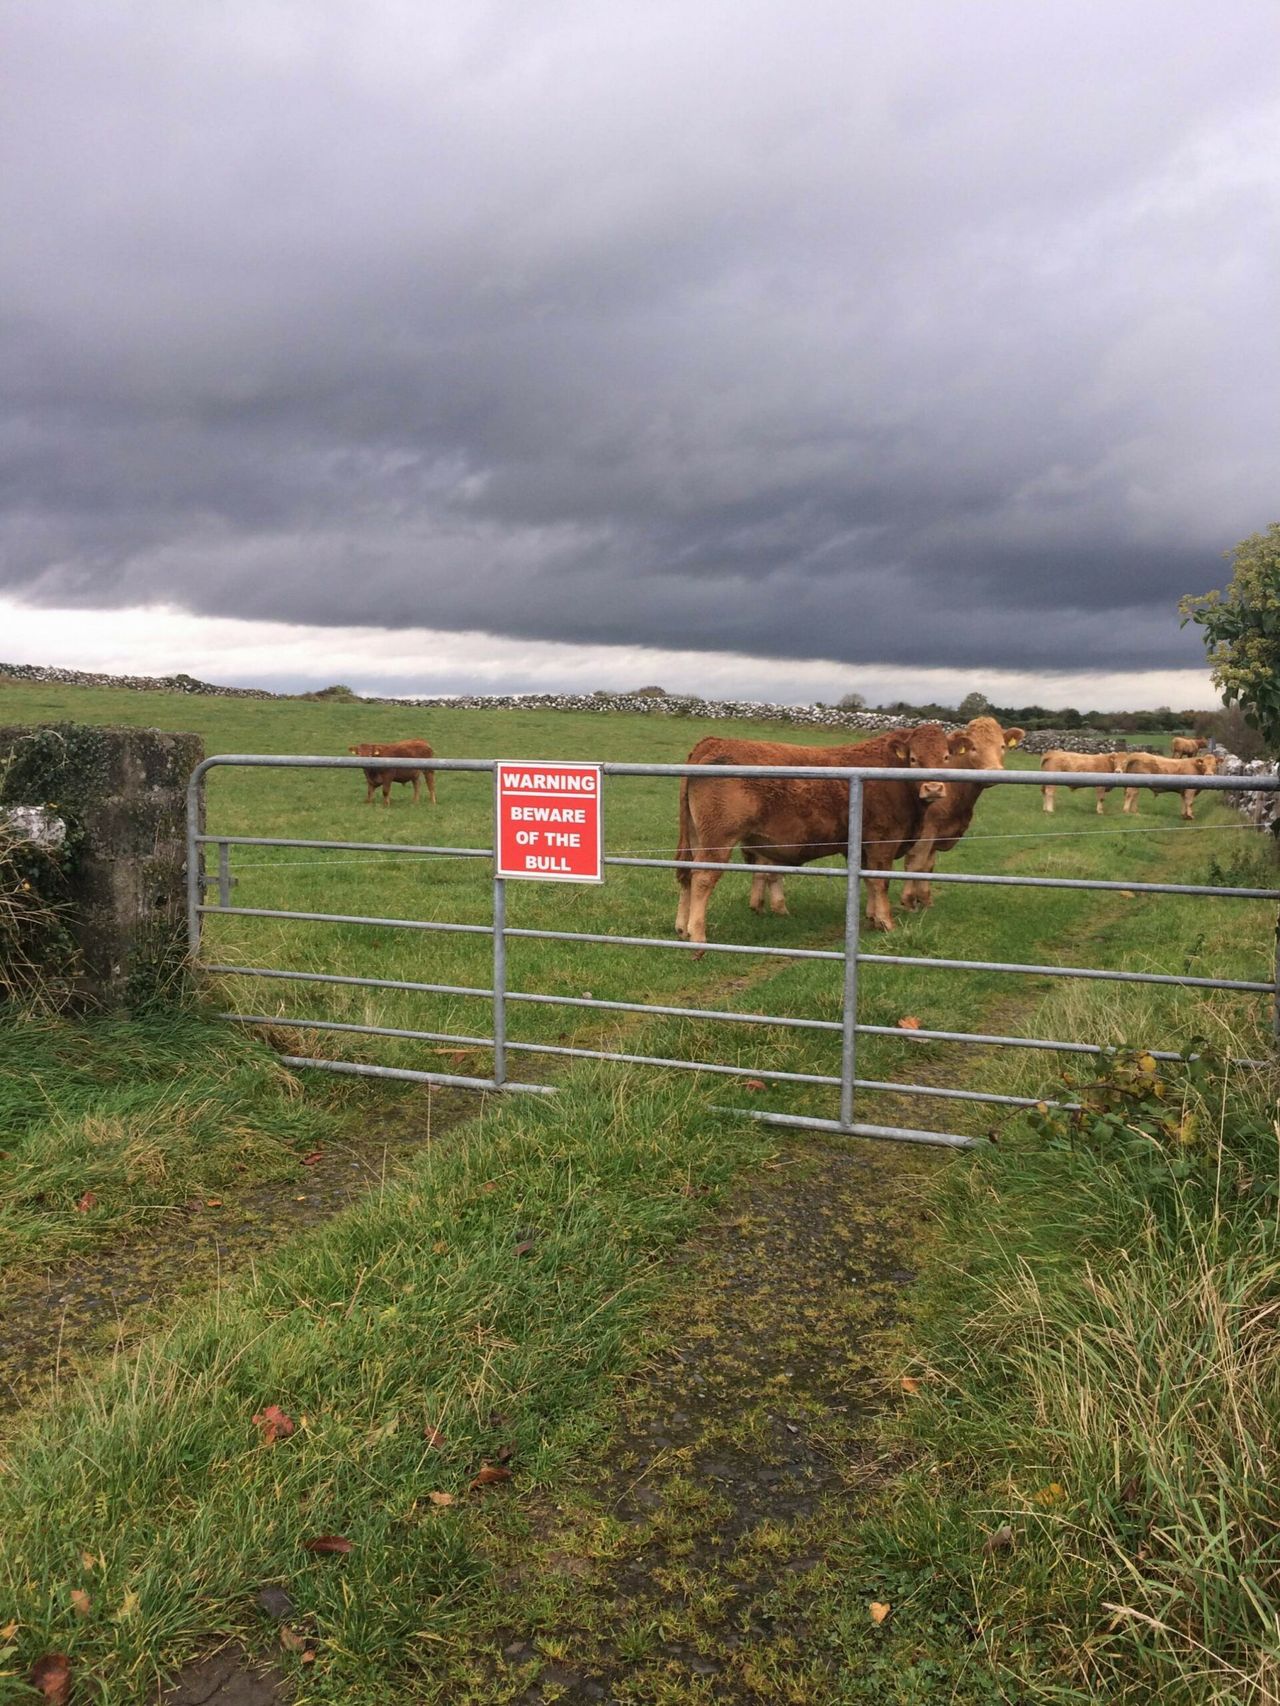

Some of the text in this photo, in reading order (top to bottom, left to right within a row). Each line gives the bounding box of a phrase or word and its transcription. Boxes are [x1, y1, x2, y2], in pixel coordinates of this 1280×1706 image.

[503, 773, 596, 791] WARNING
[511, 806, 586, 823] BEWARE
[515, 831, 581, 848] OF THE
[525, 855, 572, 871] BULL
